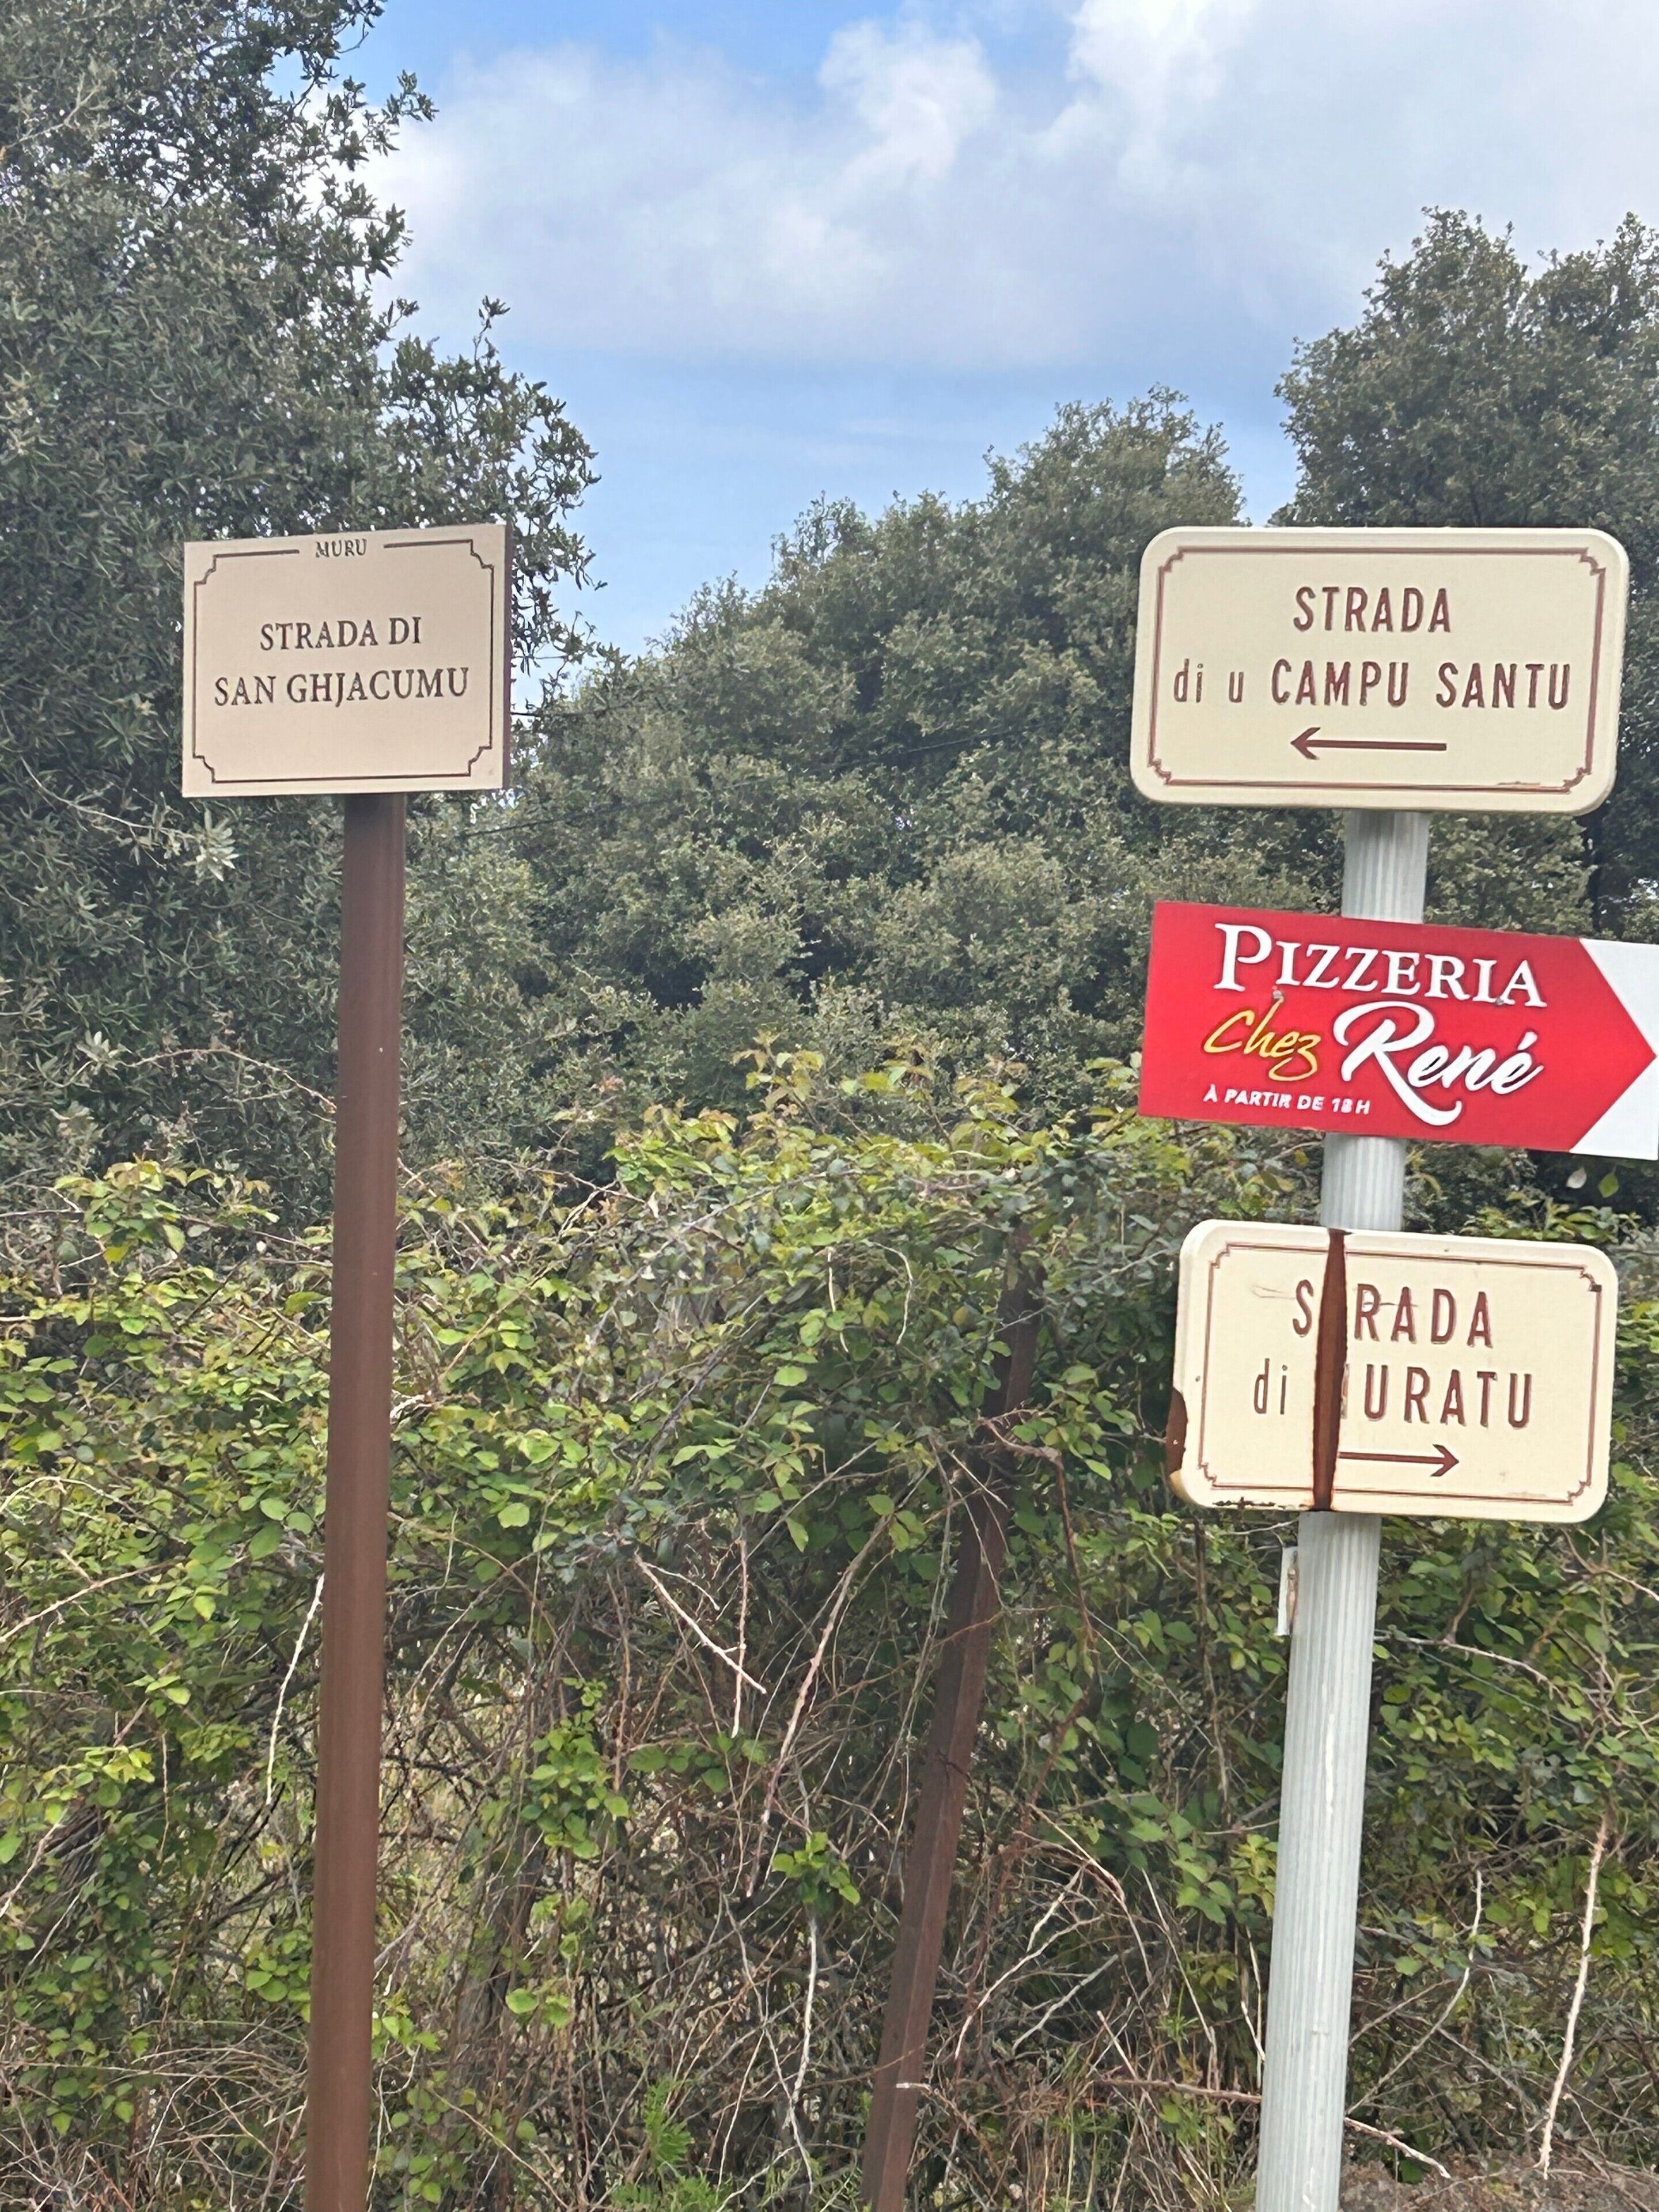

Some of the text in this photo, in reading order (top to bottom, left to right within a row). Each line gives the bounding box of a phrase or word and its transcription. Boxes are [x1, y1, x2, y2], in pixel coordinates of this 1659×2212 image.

[315, 539, 368, 558] MURU
[1293, 586, 1451, 632] STRADA
[260, 617, 421, 650] STRADA DI
[214, 668, 469, 707] SAN GHJACUMU
[1173, 658, 1571, 710] di u CAMPU SANTU
[1203, 995, 1544, 1126] Chez René
[1225, 1089, 1290, 1109] PARTIR
[1297, 1095, 1324, 1112] DE
[1292, 1279, 1492, 1348] SRADA
[1254, 1358, 1533, 1429] di URATU
